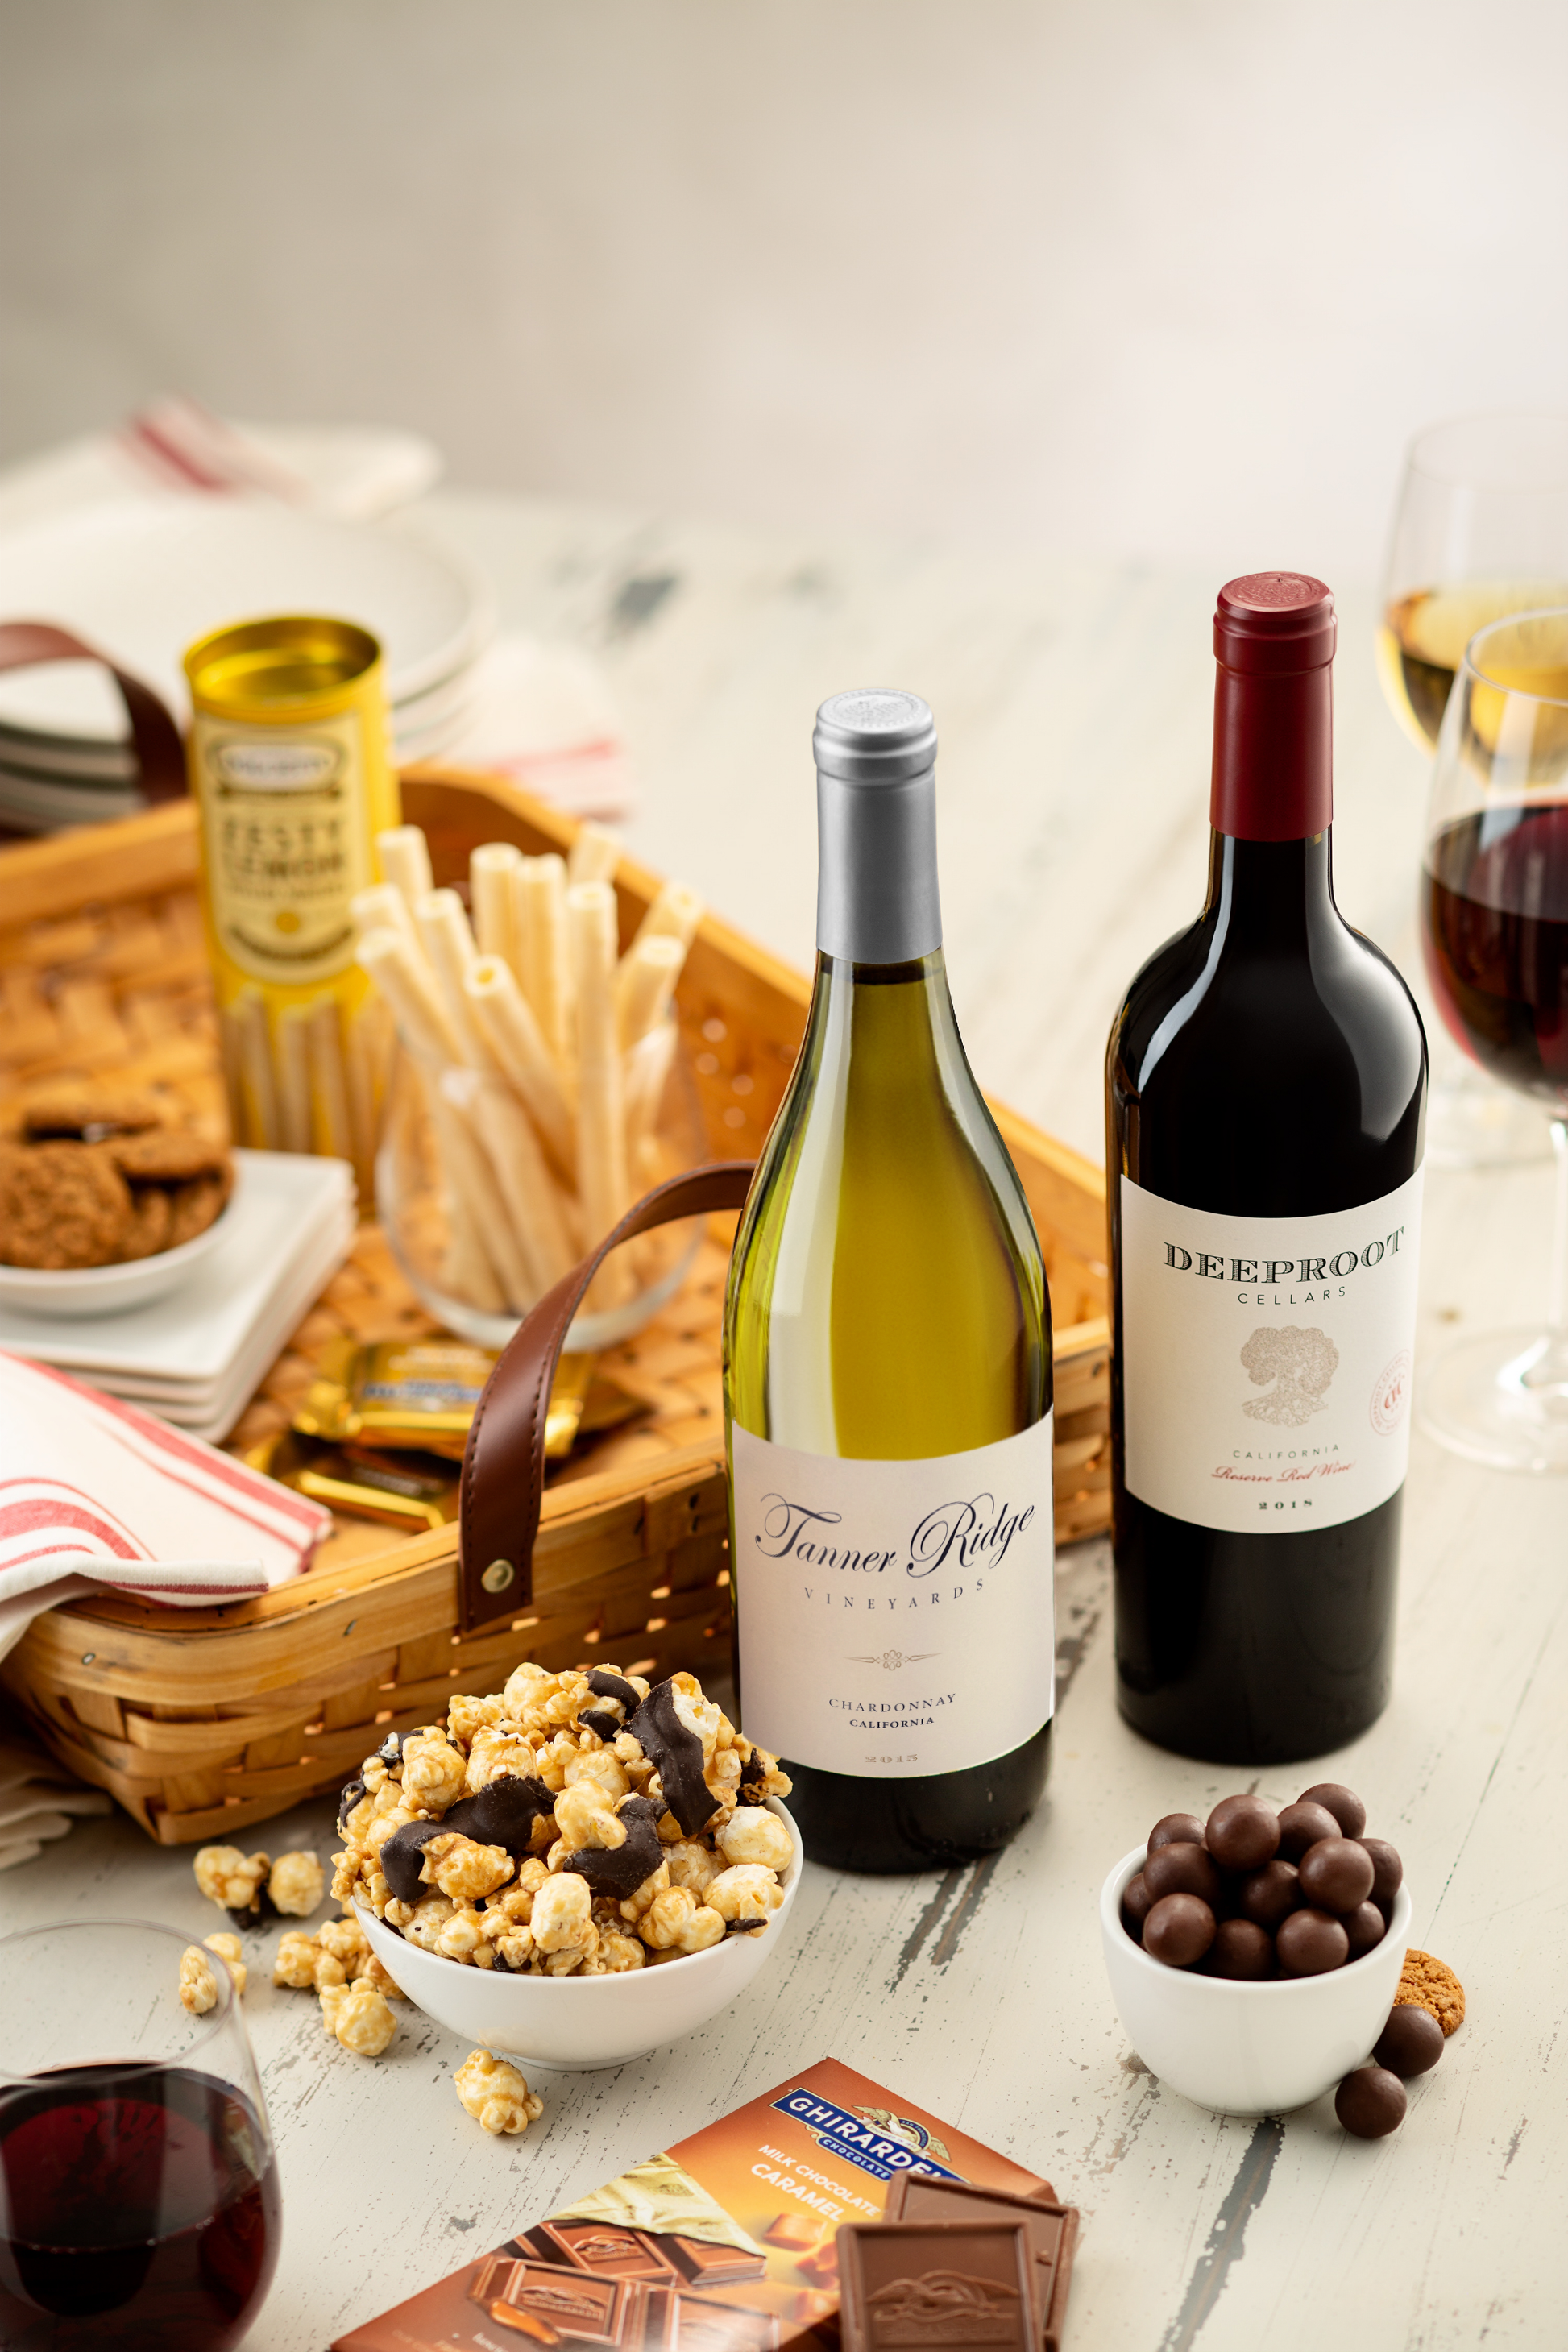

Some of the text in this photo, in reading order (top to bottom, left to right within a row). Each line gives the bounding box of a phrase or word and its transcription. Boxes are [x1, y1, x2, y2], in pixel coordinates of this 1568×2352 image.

[1163, 1226, 1404, 1284] DEEPROOT
[1238, 1286, 1346, 1305] CELLARS
[1233, 1444, 1339, 1459] CALIFORNIA
[1210, 1459, 1357, 1483] Reserve Red Wine
[1259, 1499, 1313, 1511] 2018
[755, 1492, 1035, 1578] Tanner Ridge
[804, 1578, 984, 1610] VINEYARDS
[828, 1693, 956, 1713] CHARDONNAY
[849, 1717, 935, 1728] CALIFORNIA
[865, 1753, 919, 1764] 2015
[788, 2097, 942, 2178] GHIRARDE
[823, 2138, 890, 2179] CHOCOLATE
[751, 2163, 844, 2222] CARAMEL
[757, 2144, 881, 2217] MILK CHOCOLATE
